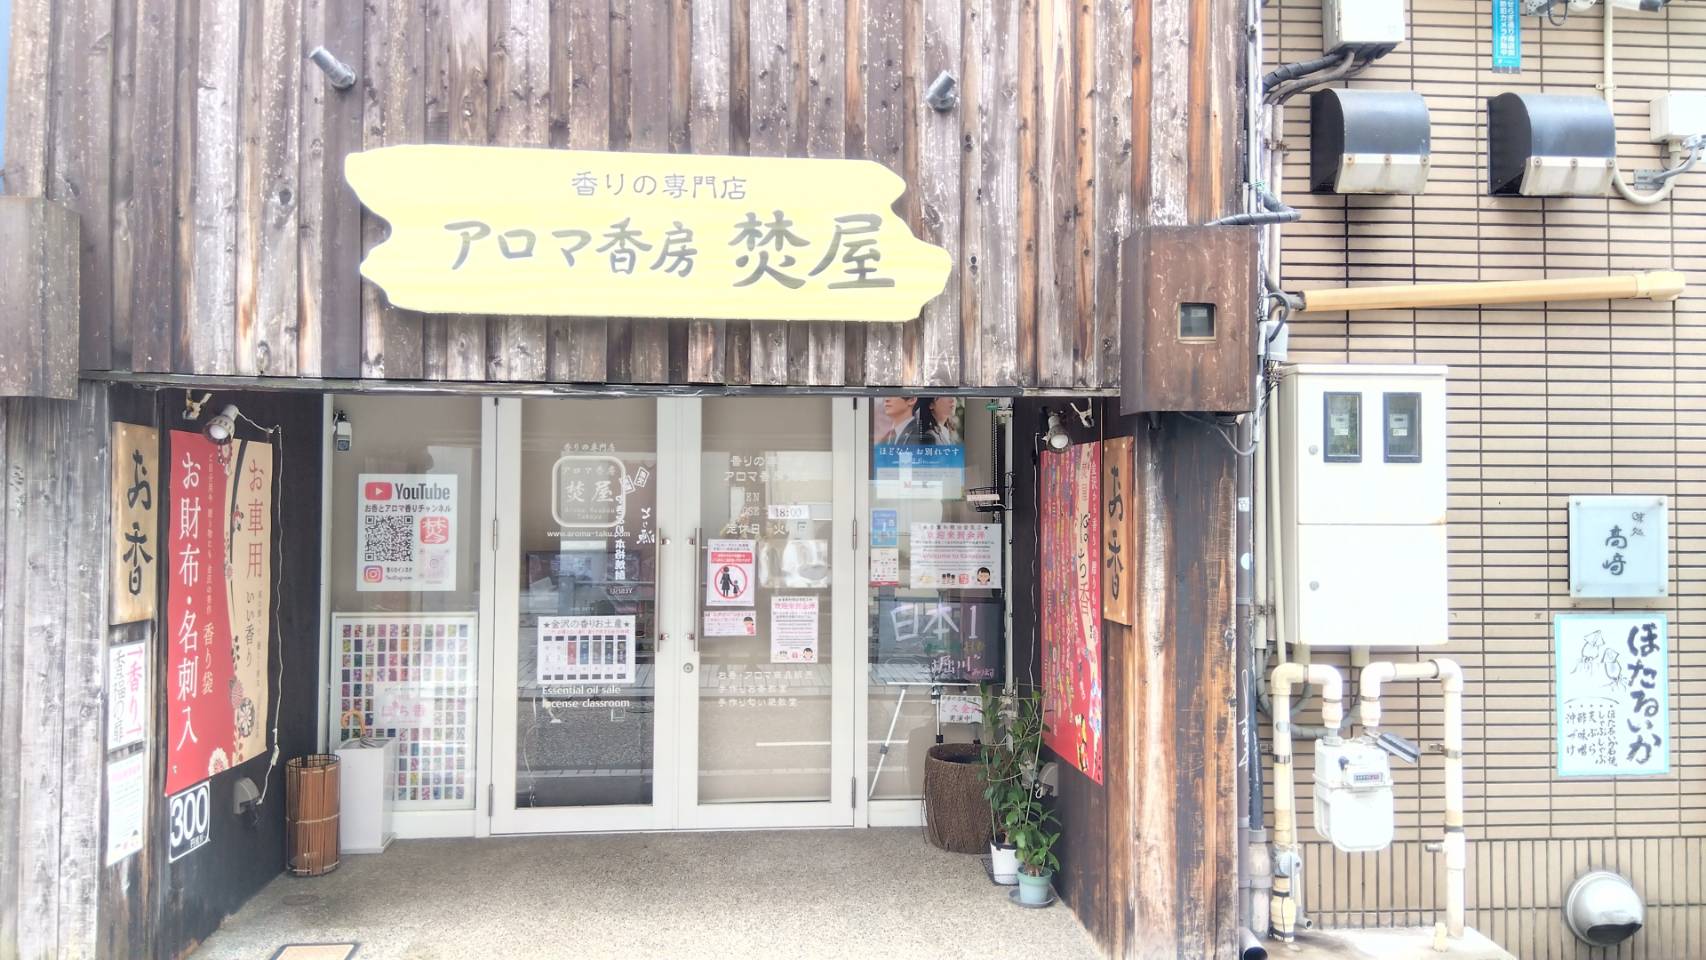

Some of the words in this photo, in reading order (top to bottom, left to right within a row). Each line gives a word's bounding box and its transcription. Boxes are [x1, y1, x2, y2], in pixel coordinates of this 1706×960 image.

[571, 171, 747, 200] 香りの専門店
[444, 216, 699, 278] アロマ香房
[728, 210, 896, 290] 焚屋
[123, 449, 154, 595] お香
[246, 459, 264, 579] お車用
[365, 504, 451, 513] お香とアロマ香りチャンネル
[395, 482, 450, 500] YouTube
[566, 480, 614, 502] 焚屋
[178, 452, 202, 751] お財布・名刺入
[201, 623, 216, 695] 香り袋
[542, 685, 584, 695] Essential
[586, 685, 599, 695] oil
[602, 685, 621, 695] sale
[582, 698, 630, 708] classroom
[1627, 622, 1661, 765] ほたるいか
[171, 786, 208, 848] 300
